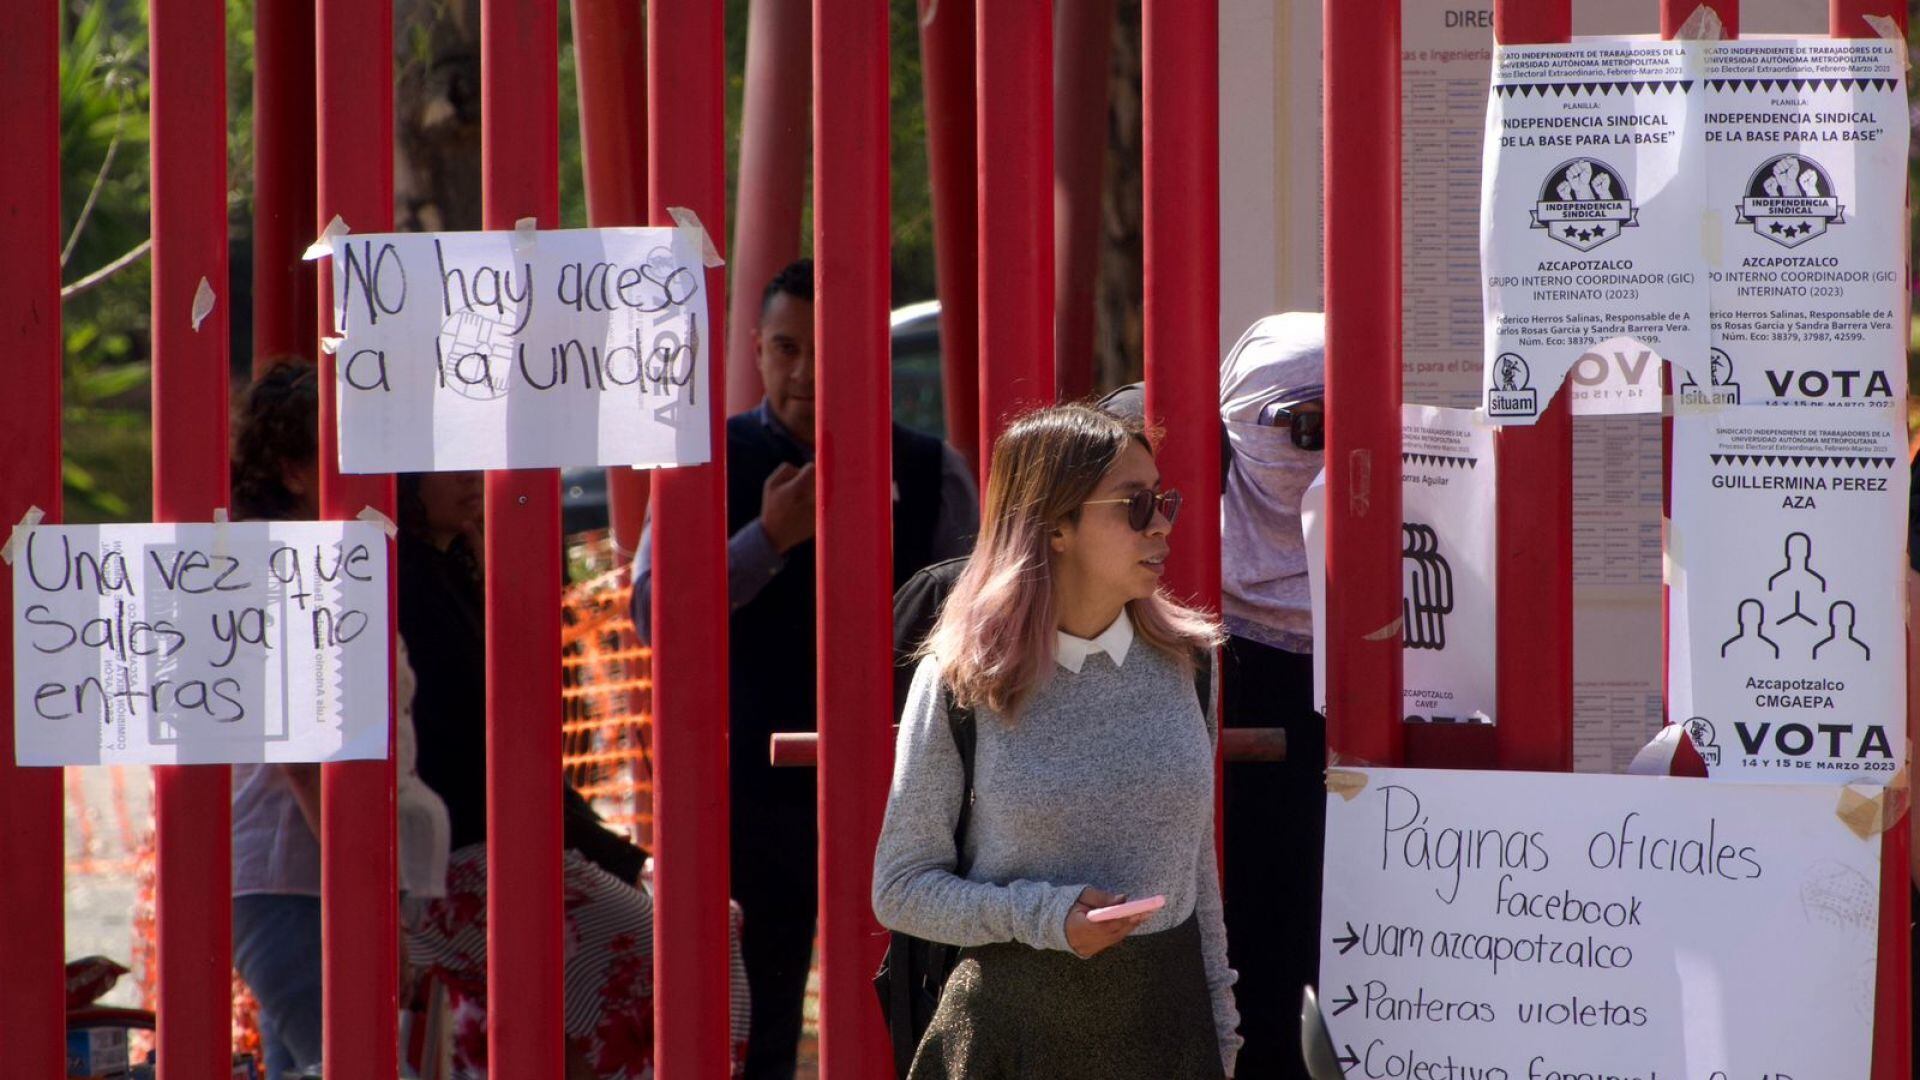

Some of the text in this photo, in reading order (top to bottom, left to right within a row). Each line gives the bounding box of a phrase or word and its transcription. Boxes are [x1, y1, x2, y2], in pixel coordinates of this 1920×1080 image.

[1522, 51, 1584, 59] INDEPENDIENTE
[1600, 49, 1661, 58] TRABAJADORES
[1663, 48, 1675, 56] DE
[1796, 47, 1807, 55] DE
[1810, 47, 1870, 55] TRABAJADORES
[1602, 58, 1669, 67] METROPOLITANA
[1811, 56, 1879, 64] METROPOLITANA
[1513, 70, 1547, 78] Electoral
[1607, 67, 1663, 75] Febrero-Marzo
[1757, 66, 1814, 74] Extraordinario,
[1816, 65, 1873, 73] Febrero-Marzo
[1563, 102, 1600, 110] PLANILLA:
[1771, 98, 1809, 106] PLANILLA:
[1503, 114, 1668, 130] NDEPENDENCIA SINDICAL
[1705, 112, 1877, 125] INDEPENDENCIA SINDICAL
[1519, 135, 1534, 147] LA
[1539, 134, 1572, 146] BASE
[1576, 134, 1609, 146] PARA
[1614, 133, 1630, 145] LA
[1705, 130, 1723, 142] DE
[1726, 130, 1743, 142] LA
[1746, 130, 1779, 142] BASE
[1782, 130, 1818, 142] PARA
[1824, 130, 1839, 141] LA
[1546, 202, 1623, 212] INDEPENDENCIA
[1752, 199, 1829, 208] INDEPENDENCIA
[1562, 210, 1607, 218] SINDICAL
[1768, 206, 1813, 215] SINDICAL
[1538, 260, 1633, 271] AZCAPOTZALCO
[1742, 256, 1839, 268] AZCAPOTZALCO
[1522, 276, 1573, 287] INTERNO
[1576, 274, 1664, 285] COORDINADOR
[1668, 273, 1695, 285] (GIC)
[1726, 272, 1777, 283] INTERNO
[1780, 272, 1869, 283] COORDINADOR
[342, 238, 699, 336] NO hay acceso
[1738, 286, 1844, 298] INTERINATO (2023)
[1533, 290, 1639, 301] INTERINATO (2023)
[1532, 312, 1690, 324] Herros Salinas, Responsable de A
[1710, 310, 1894, 321] erico Herros Salinas, Responsable de A
[1522, 326, 1548, 335] Rosas
[1584, 327, 1589, 336] y
[1592, 324, 1625, 333] Sandra
[1628, 324, 1664, 332] Barrera
[1666, 324, 1690, 332] Vera.
[1725, 322, 1752, 330] Rosas
[1787, 323, 1793, 332] y
[1795, 321, 1829, 330] Sandra
[1832, 322, 1868, 330] Barrera
[1870, 322, 1893, 330] Vera.
[1547, 337, 1566, 346] Eco:
[1722, 333, 1865, 342] Núm. Eco: 38379, 37987, 42599.
[346, 348, 390, 392] a
[436, 336, 495, 394] la
[519, 312, 697, 406] unidad
[1765, 370, 1893, 398] VOTA
[1492, 398, 1533, 411] situam
[1422, 475, 1449, 487] Aguilar
[1712, 475, 1887, 492] GUILLERMINA PEREZ
[1782, 496, 1816, 509] AZA
[27, 531, 134, 597] Una
[150, 549, 253, 594] vez
[270, 544, 373, 611] que
[210, 607, 274, 668] ya
[312, 607, 368, 651] no
[1746, 677, 1845, 692] Azcapotzalco
[34, 667, 245, 724] entras
[1755, 695, 1835, 709] CMGAEPA
[1734, 722, 1894, 759] VOTA
[1742, 759, 1896, 772] 14 Y 15 DE MARZO 2023
[1377, 784, 1762, 904] Páginas oficiales
[1496, 874, 1643, 927] facebook
[1431, 928, 1633, 975] azcapotzalco
[1365, 979, 1648, 1028] Panteras violetas
